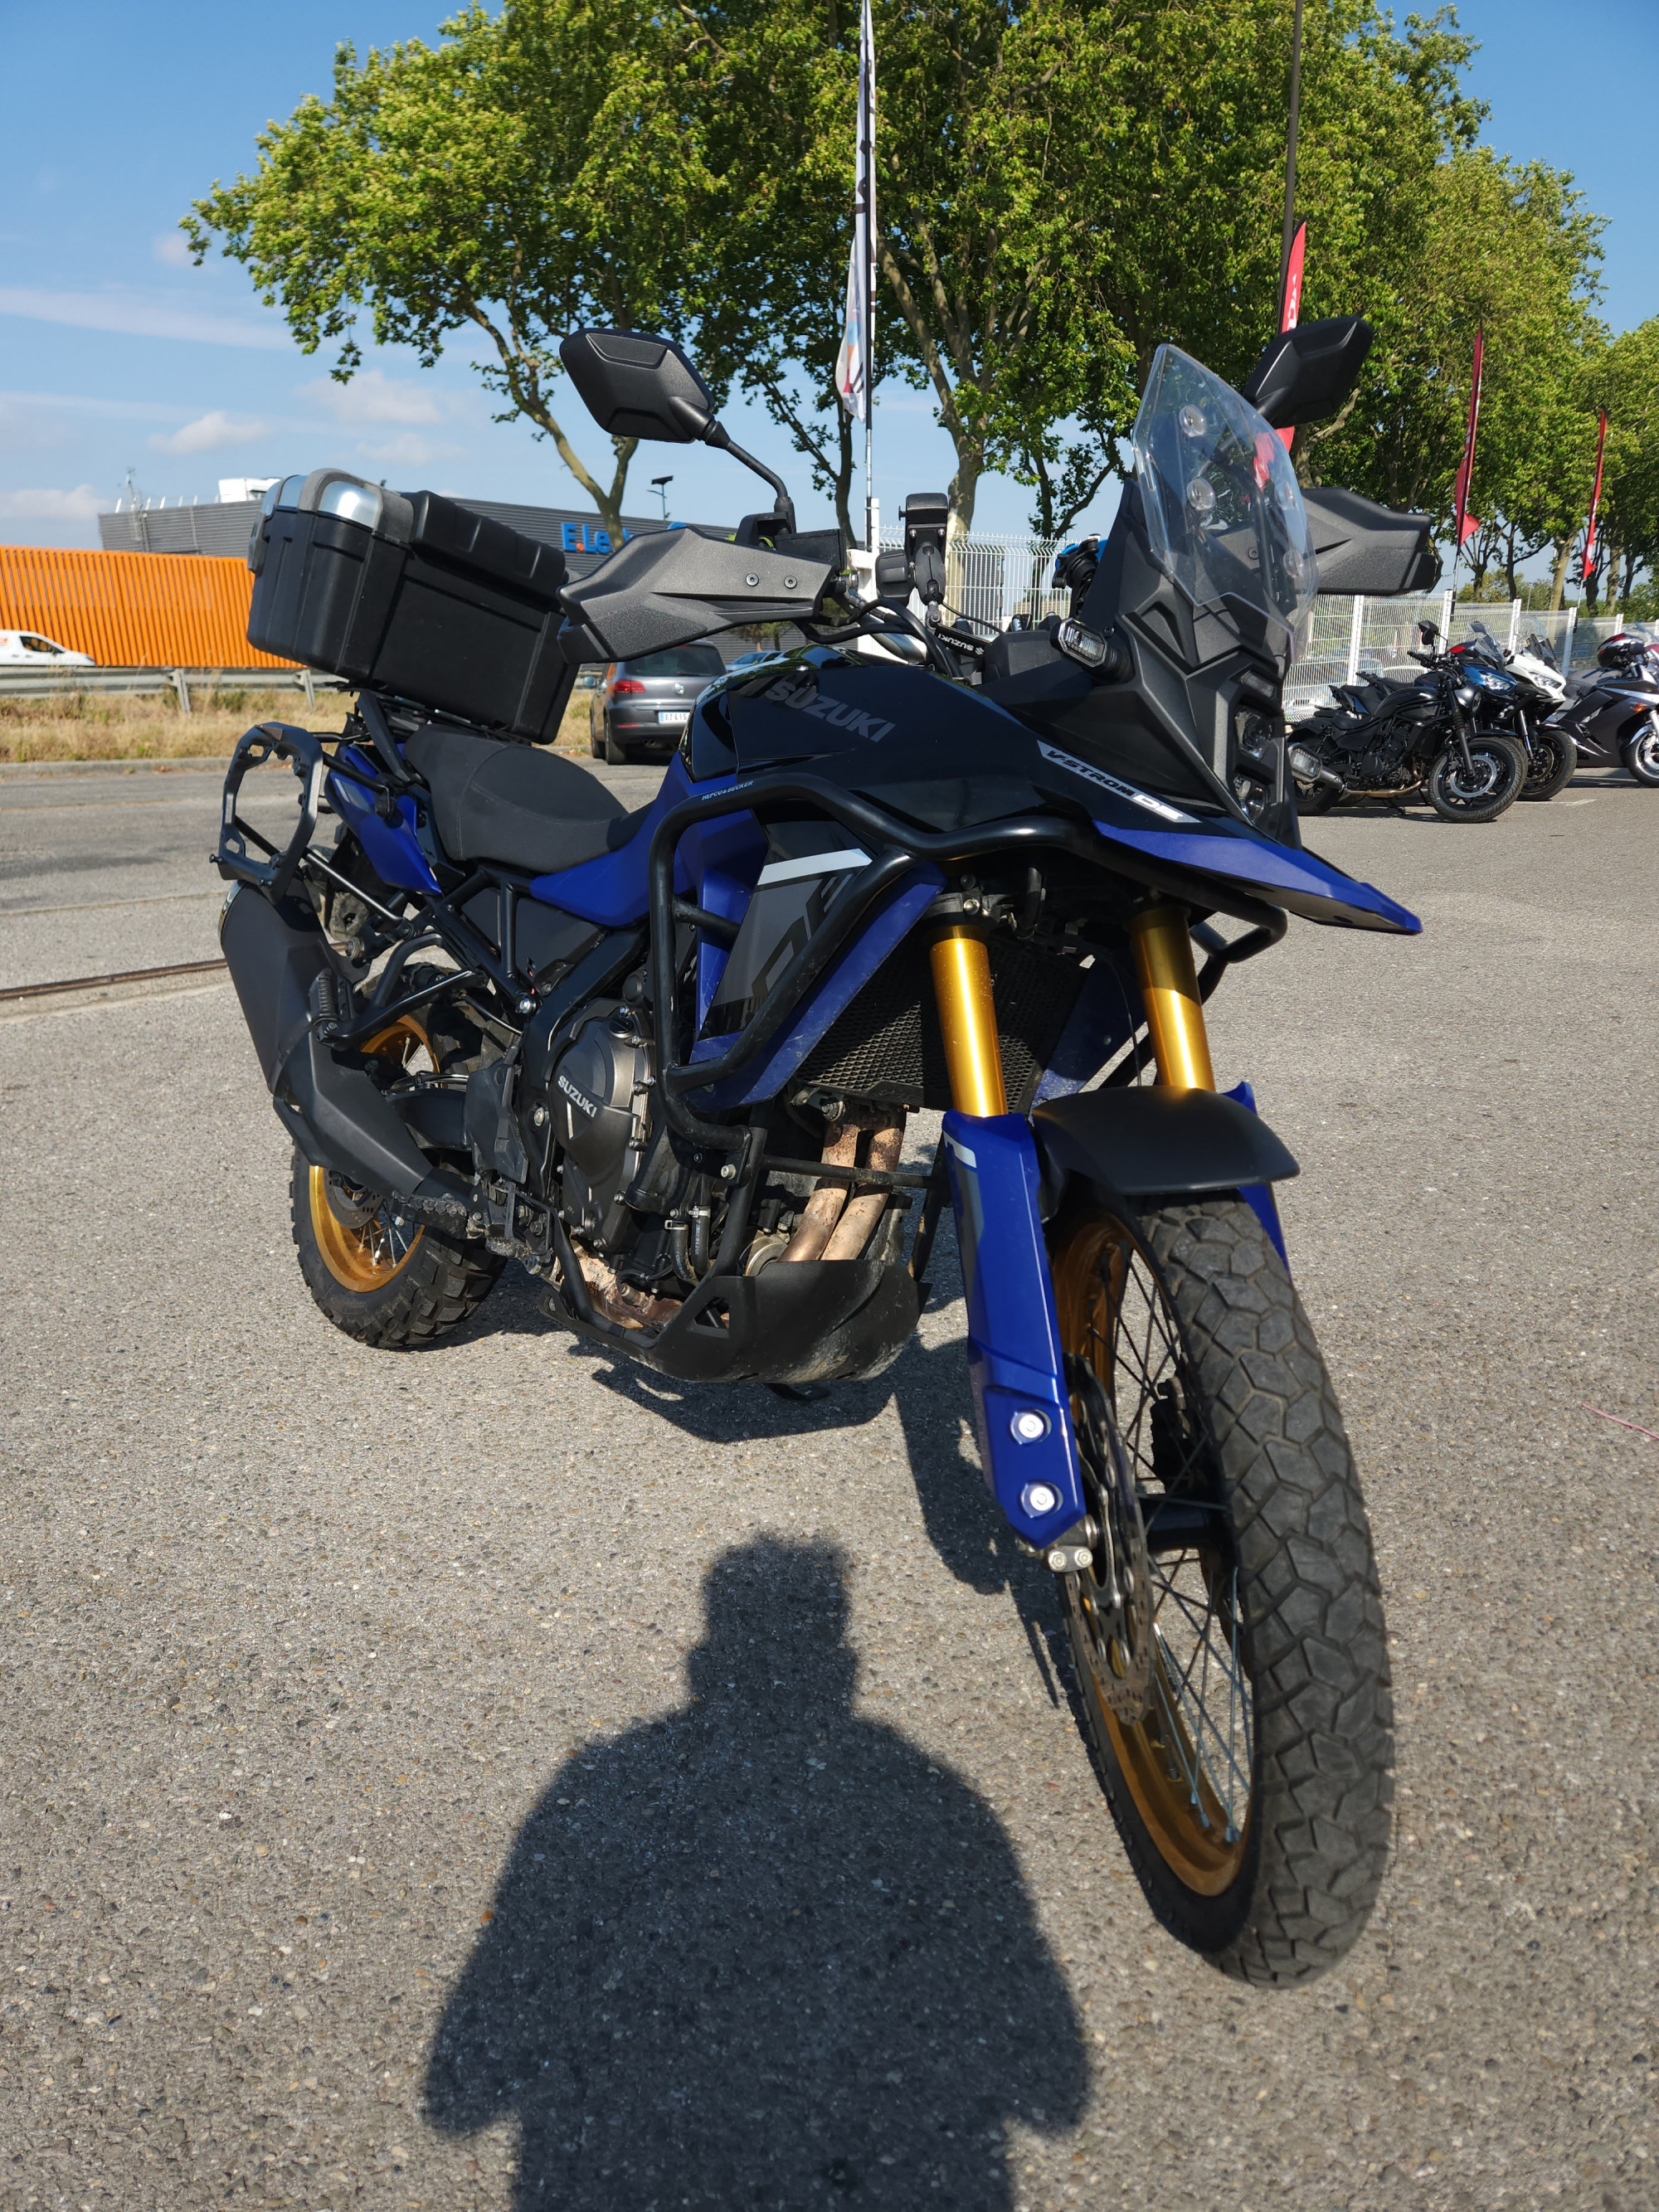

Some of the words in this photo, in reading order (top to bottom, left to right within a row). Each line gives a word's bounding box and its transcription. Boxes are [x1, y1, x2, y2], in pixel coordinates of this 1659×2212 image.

[937, 633, 975, 651] SUZUKI
[765, 681, 897, 743] SUZUKI
[1046, 750, 1136, 797] V-STROM
[557, 1075, 598, 1118] SUZUKI
